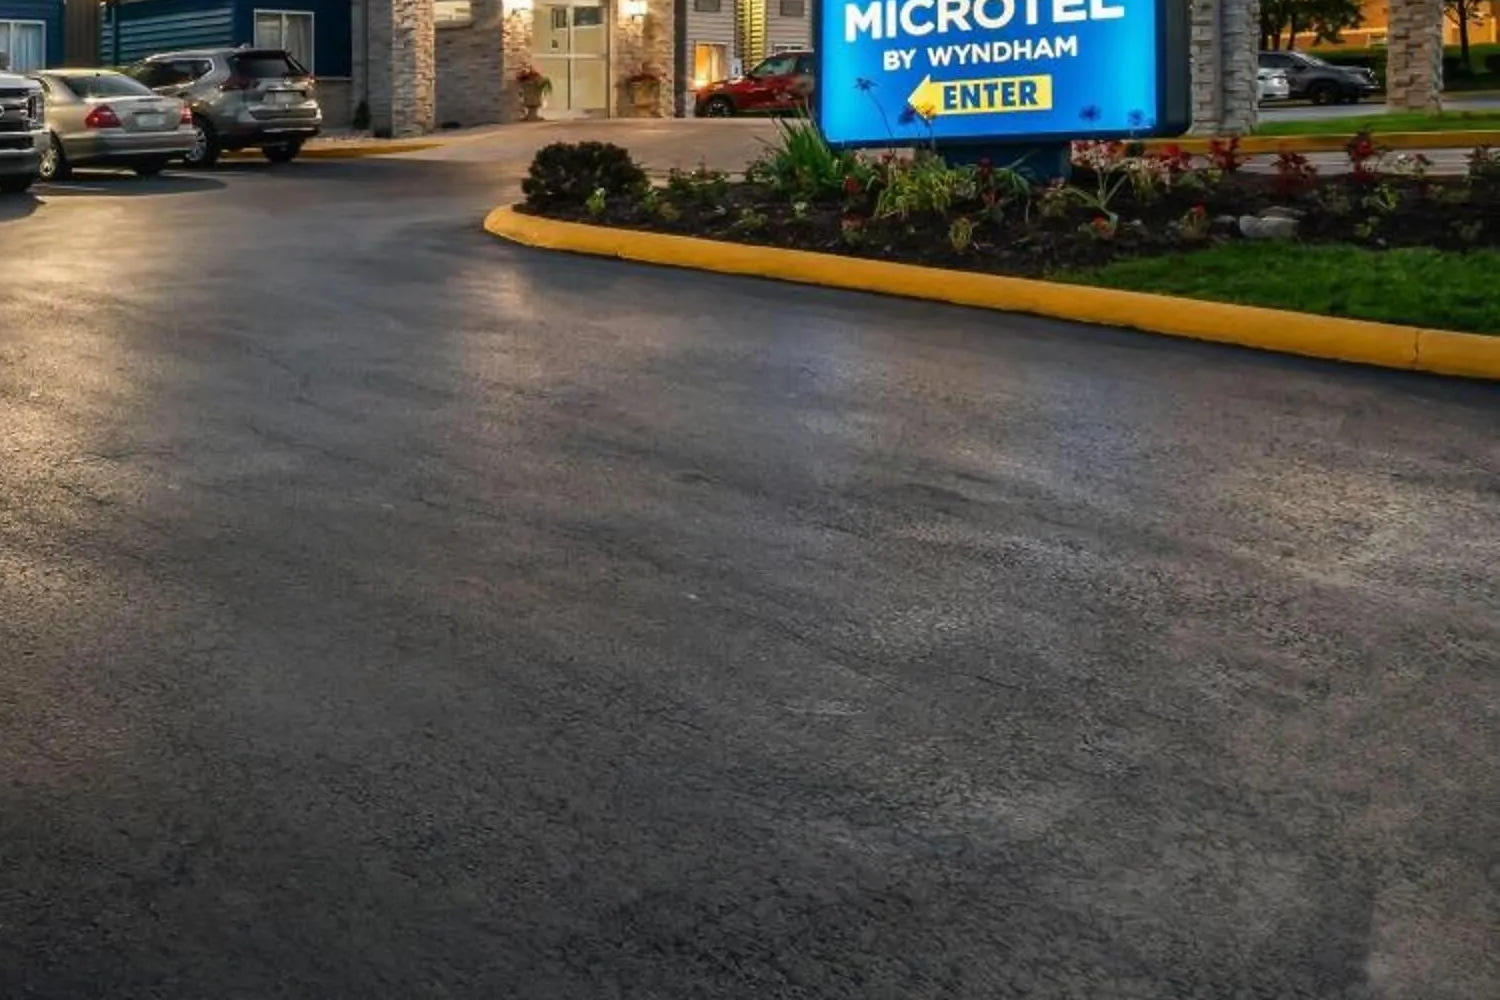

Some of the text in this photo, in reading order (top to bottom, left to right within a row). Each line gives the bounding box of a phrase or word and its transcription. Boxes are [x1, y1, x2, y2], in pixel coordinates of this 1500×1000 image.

[883, 36, 1077, 71] BY WYNDHAM
[943, 81, 1038, 110] ENTER
